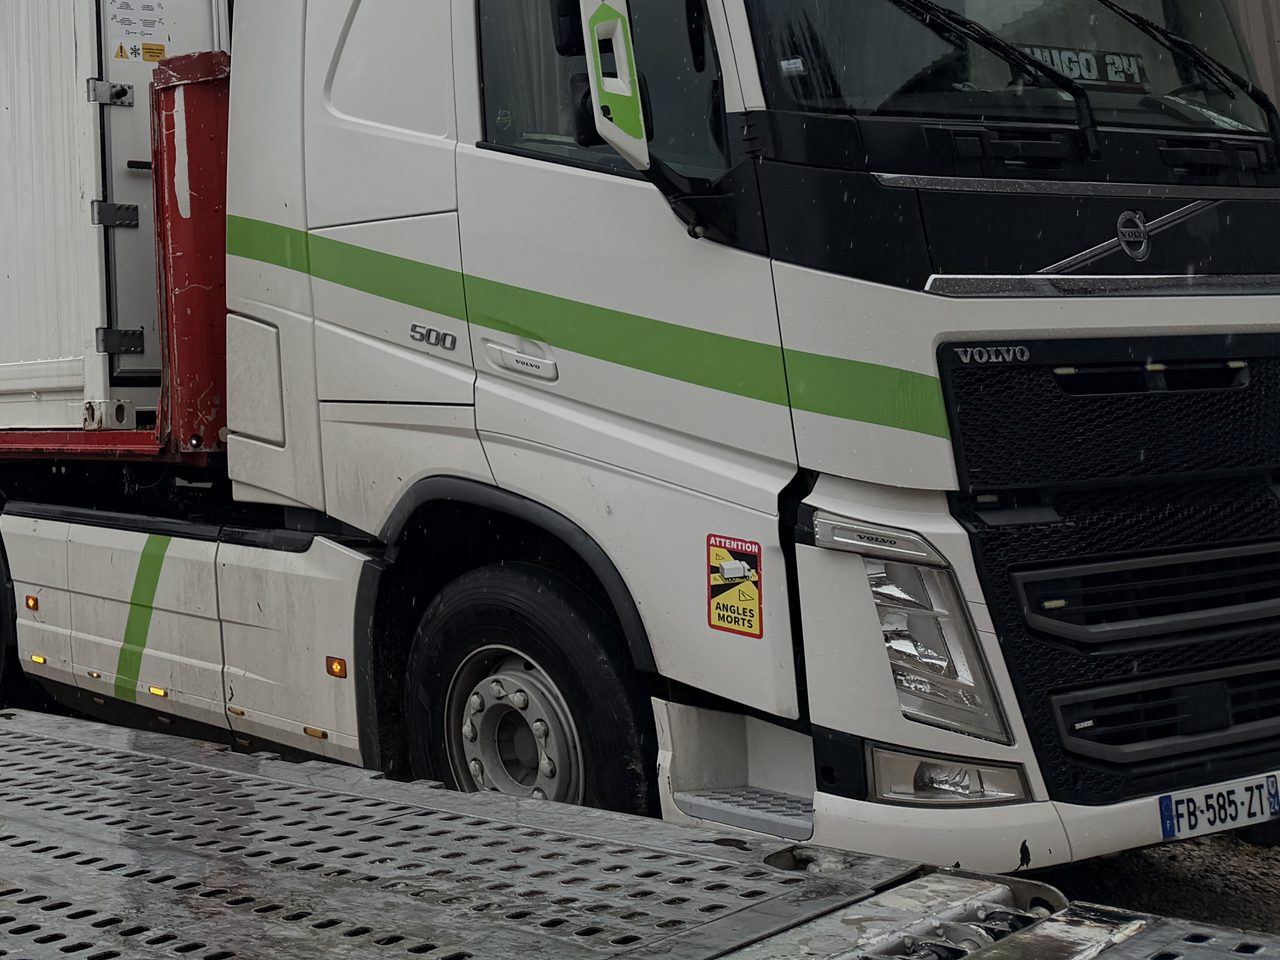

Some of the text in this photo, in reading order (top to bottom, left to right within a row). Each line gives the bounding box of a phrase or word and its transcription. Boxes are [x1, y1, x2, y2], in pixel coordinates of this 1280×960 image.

[410, 324, 457, 351] 500
[953, 346, 1030, 363] VOLVO
[515, 359, 541, 370] VOLVO
[710, 537, 759, 553] ATTENTION
[857, 534, 896, 545] VOLVO
[715, 602, 755, 618] ANGLES
[717, 613, 753, 629] MORTS
[1175, 784, 1264, 833] FB-585-ZT
